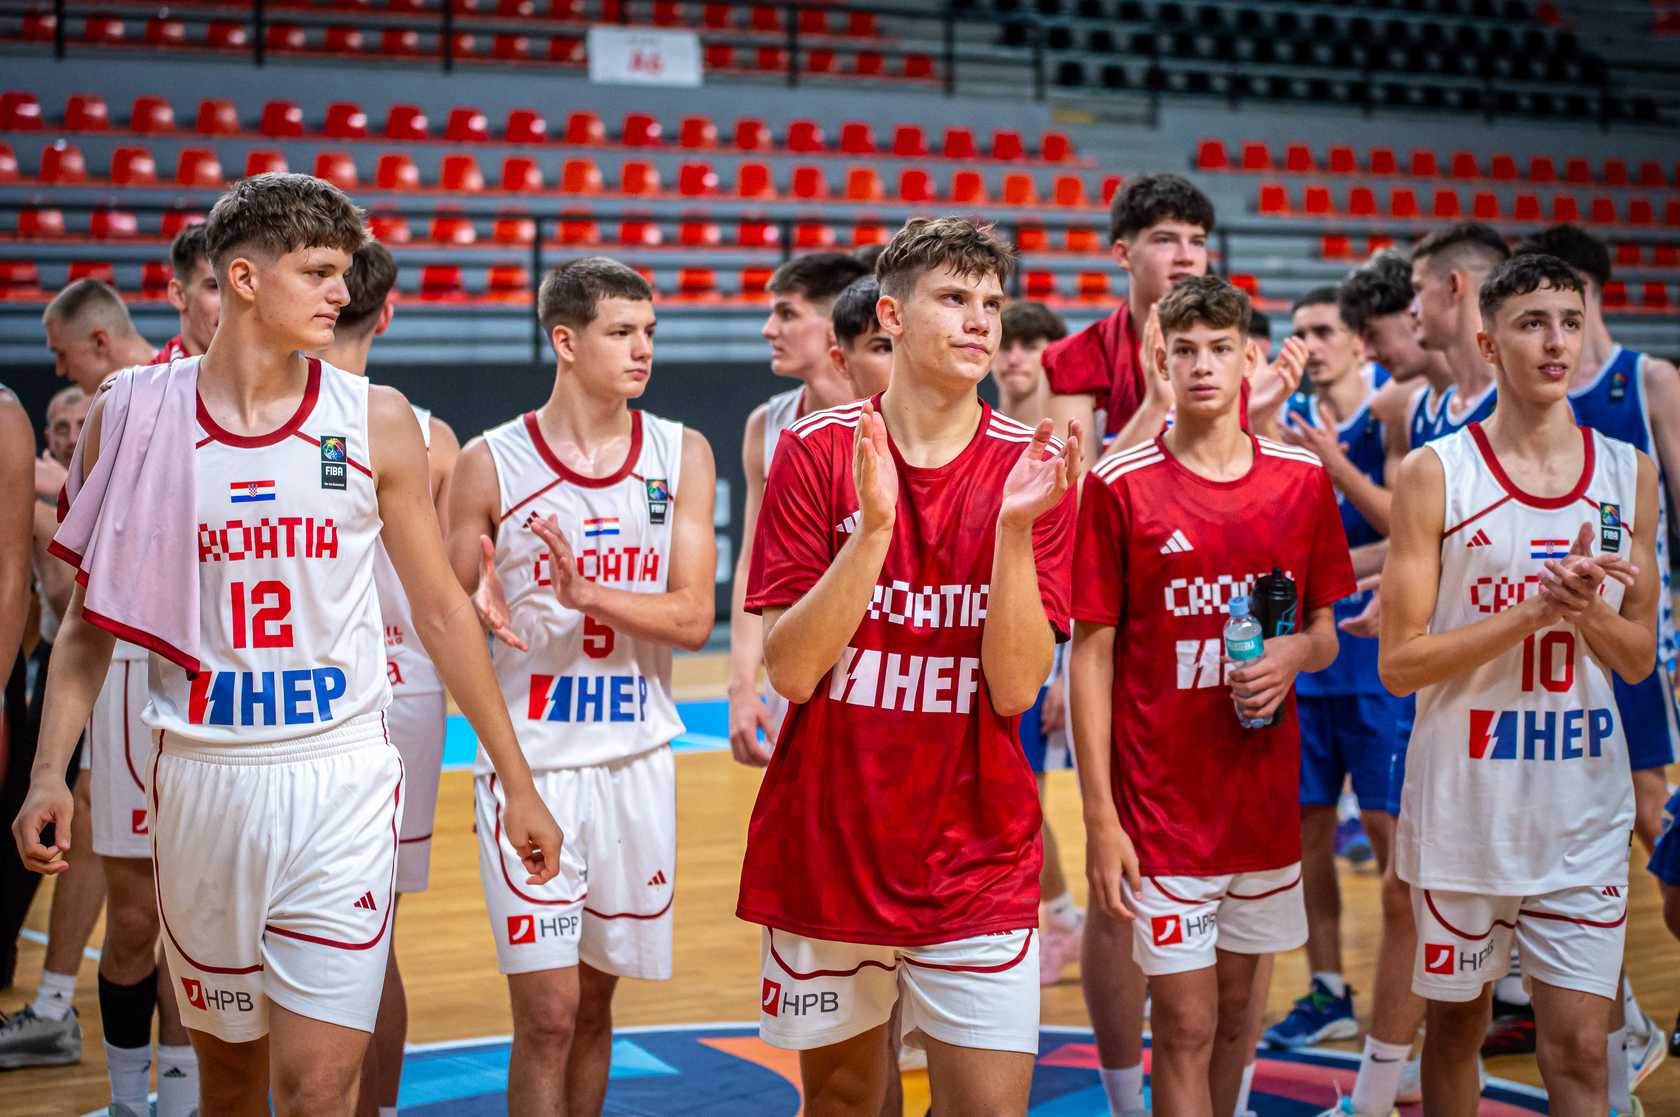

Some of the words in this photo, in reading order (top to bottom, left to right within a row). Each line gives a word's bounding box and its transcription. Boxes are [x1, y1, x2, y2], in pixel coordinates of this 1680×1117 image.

[325, 465, 343, 476] FIBA
[198, 517, 338, 562] ROATIA
[230, 580, 294, 649] 12
[583, 612, 615, 659] 5
[1521, 631, 1575, 692] 10
[240, 667, 347, 726] HEP
[576, 675, 648, 722] HEP
[1523, 708, 1614, 760] HEP
[205, 987, 254, 1012] HPB
[782, 991, 839, 1016] HPB
